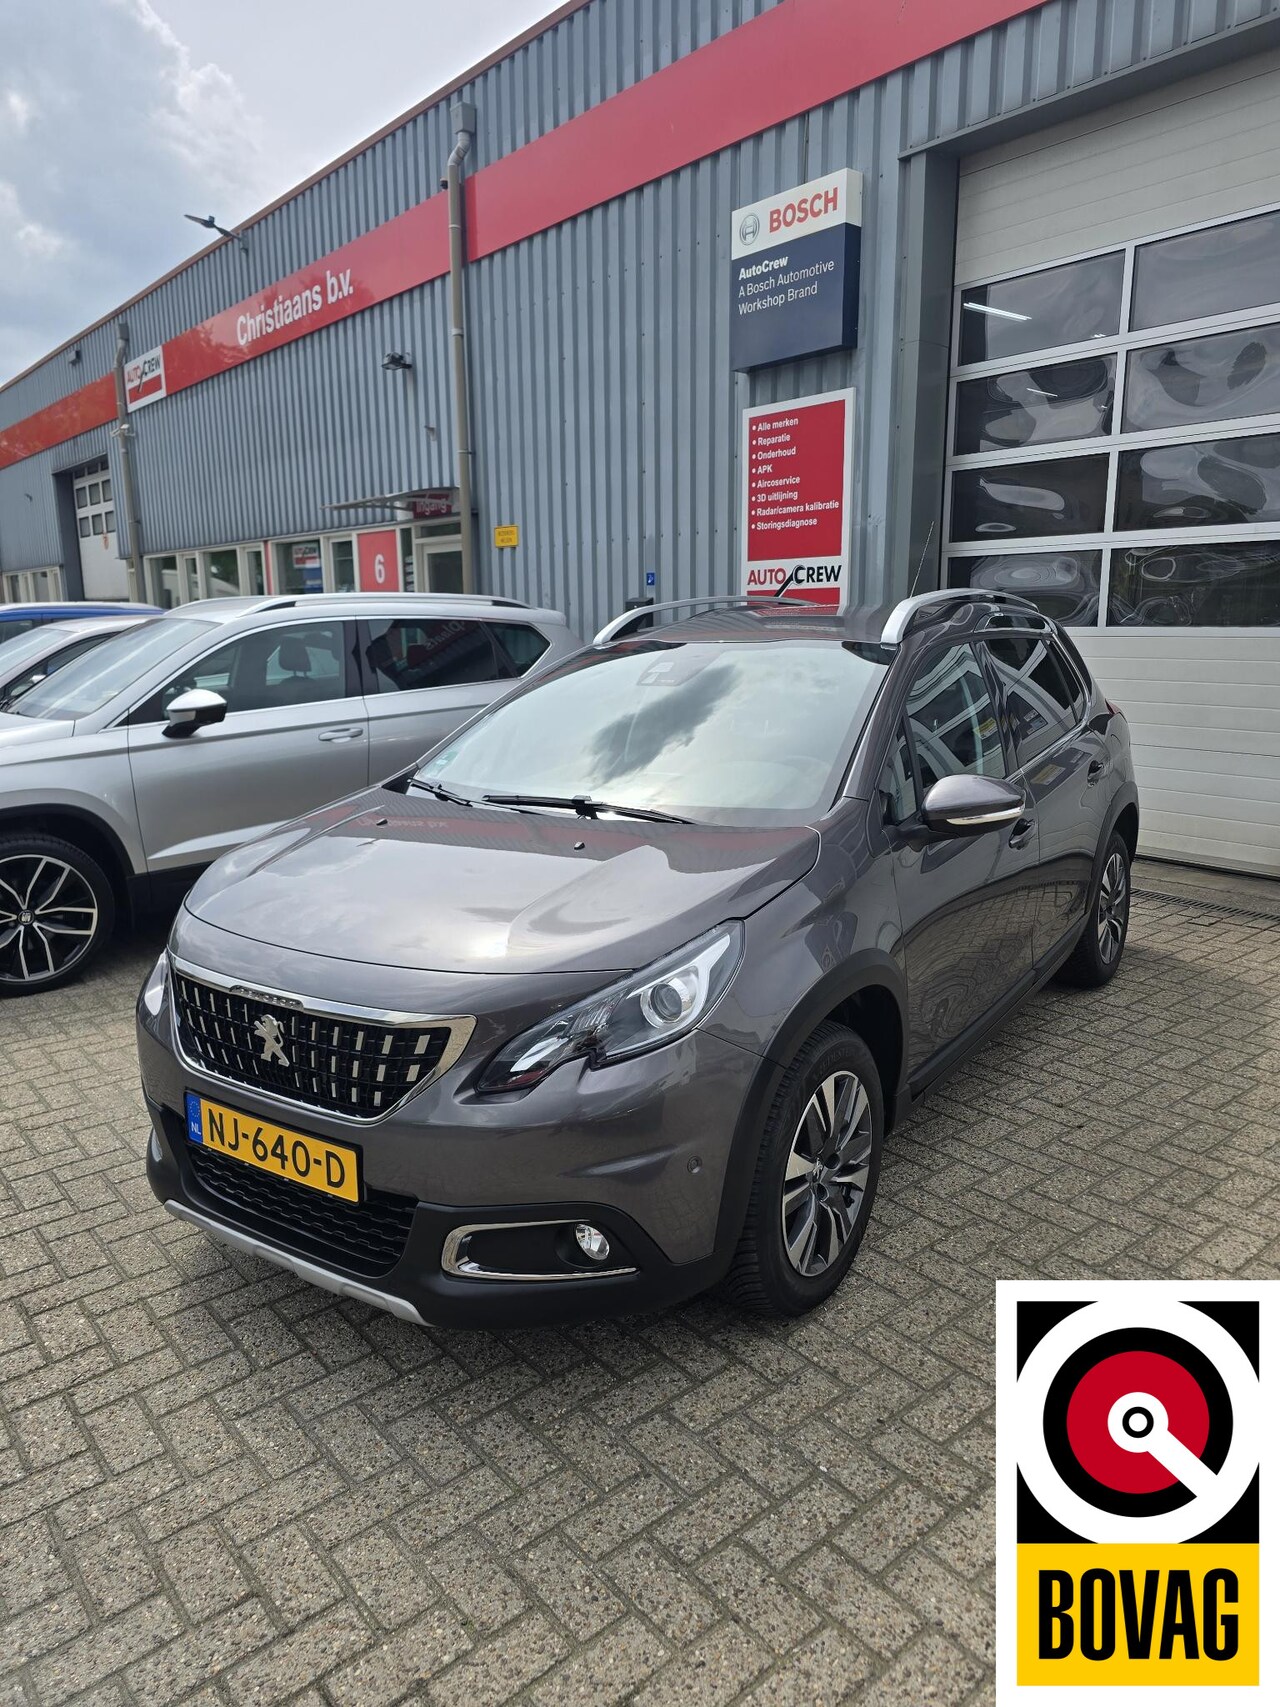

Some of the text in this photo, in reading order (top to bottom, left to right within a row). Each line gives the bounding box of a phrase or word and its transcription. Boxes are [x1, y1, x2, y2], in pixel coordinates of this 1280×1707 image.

[769, 187, 838, 233] BOSCH
[738, 256, 789, 280] AutoCrew
[738, 260, 835, 298] A Bosch Automotive
[738, 281, 818, 315] Workshop Brand
[236, 268, 354, 346] Christiaans b.v.
[757, 417, 799, 431] Alle merken
[757, 433, 791, 447] Reparatie
[757, 447, 796, 460] Onderhoud
[757, 464, 773, 474] APK
[757, 476, 800, 488] Aircoservice
[757, 490, 798, 502] 3D uitlijning
[757, 500, 839, 517] Radar/camera kalibratie
[756, 517, 818, 530] Storingsdiagnose
[374, 554, 386, 584] 6
[747, 564, 842, 585] AUTO CREW
[191, 1121, 201, 1135] NL
[208, 1108, 345, 1188] NJ-640-D
